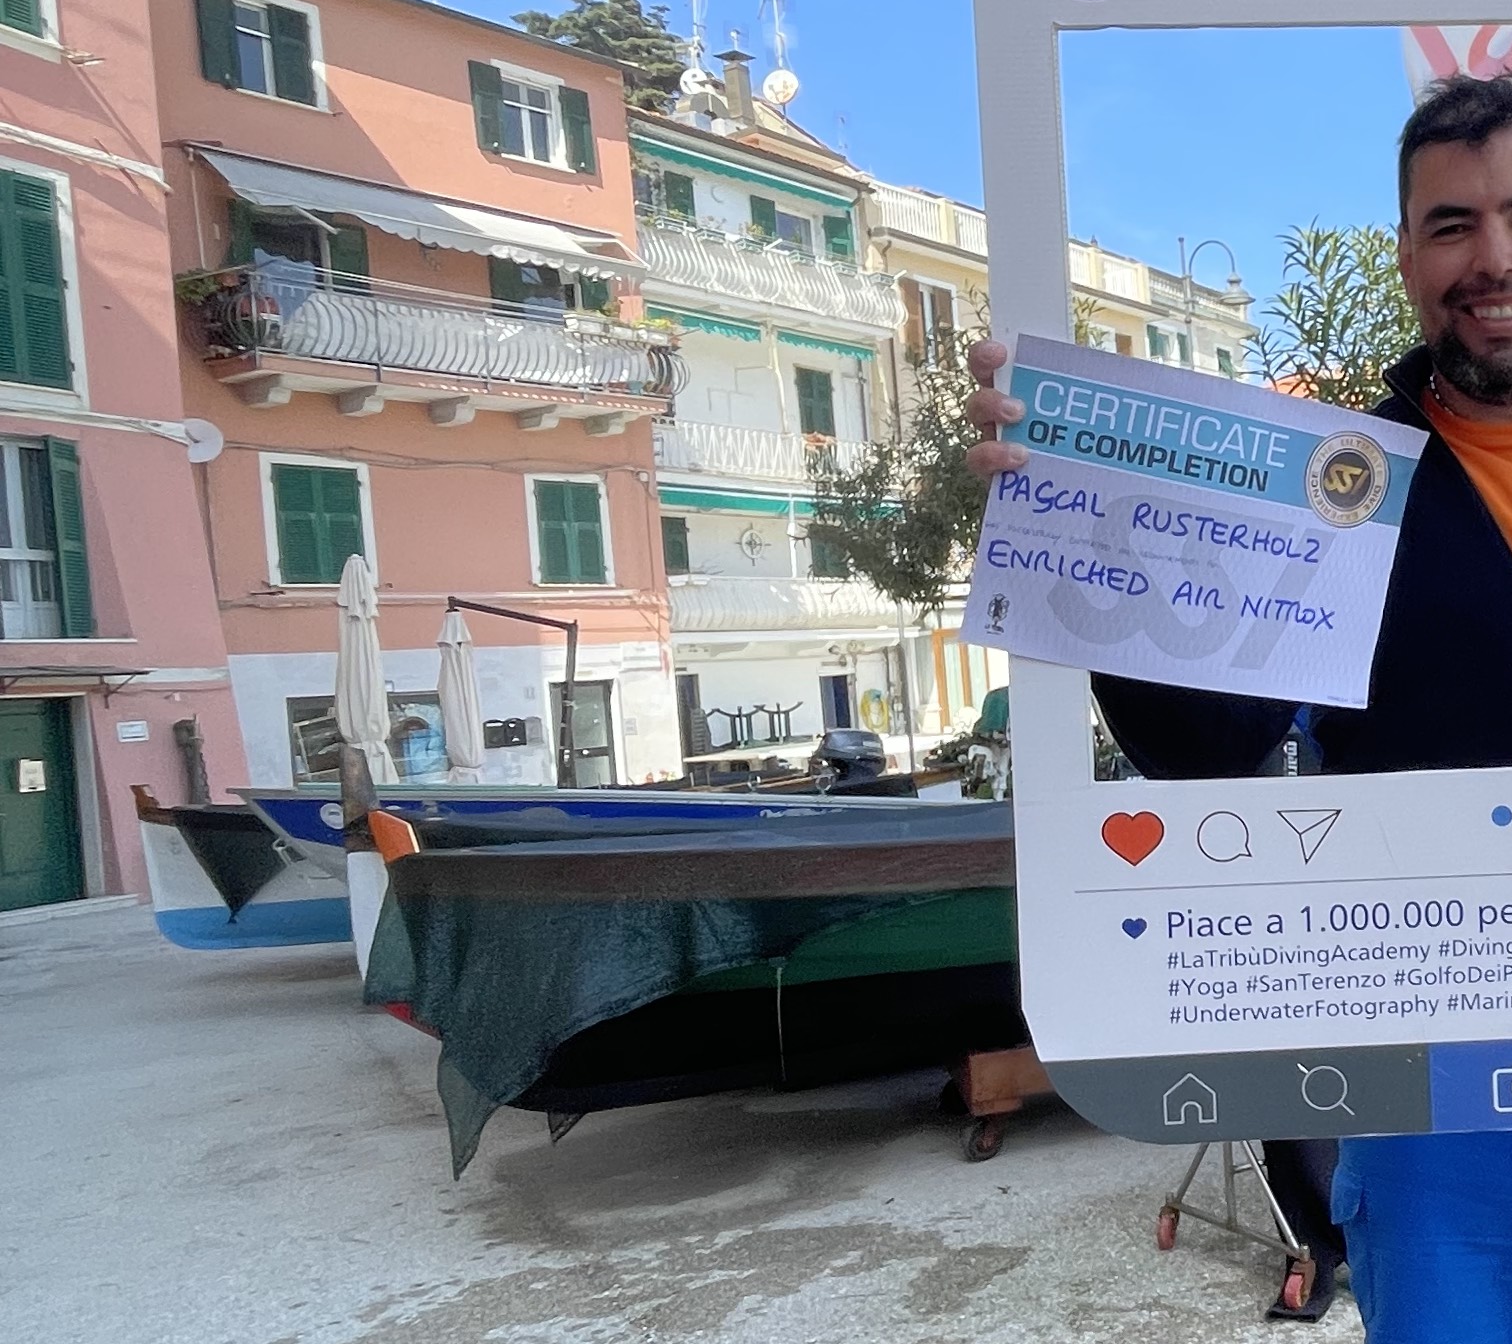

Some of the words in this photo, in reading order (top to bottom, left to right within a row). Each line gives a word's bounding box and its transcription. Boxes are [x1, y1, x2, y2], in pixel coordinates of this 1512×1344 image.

[1034, 380, 1290, 469] CERTIFICATE
[1028, 419, 1068, 447] OF
[1074, 431, 1269, 492] COMPLETION
[998, 470, 1106, 518] PASCAL
[1132, 502, 1321, 564] RUSTERHOLZ
[987, 540, 1149, 596] ENRICHED
[1172, 580, 1225, 610] AIR
[1167, 909, 1252, 938] Piace
[1266, 917, 1284, 935] a
[1300, 900, 1464, 933] 1.000.000
[1167, 942, 1431, 970] #LaTribùDivingAcademy
[1168, 977, 1238, 1000] #Yoga
[1246, 970, 1387, 994] #SanTerenzo
[1169, 993, 1439, 1025] #UnderwaterFotography
